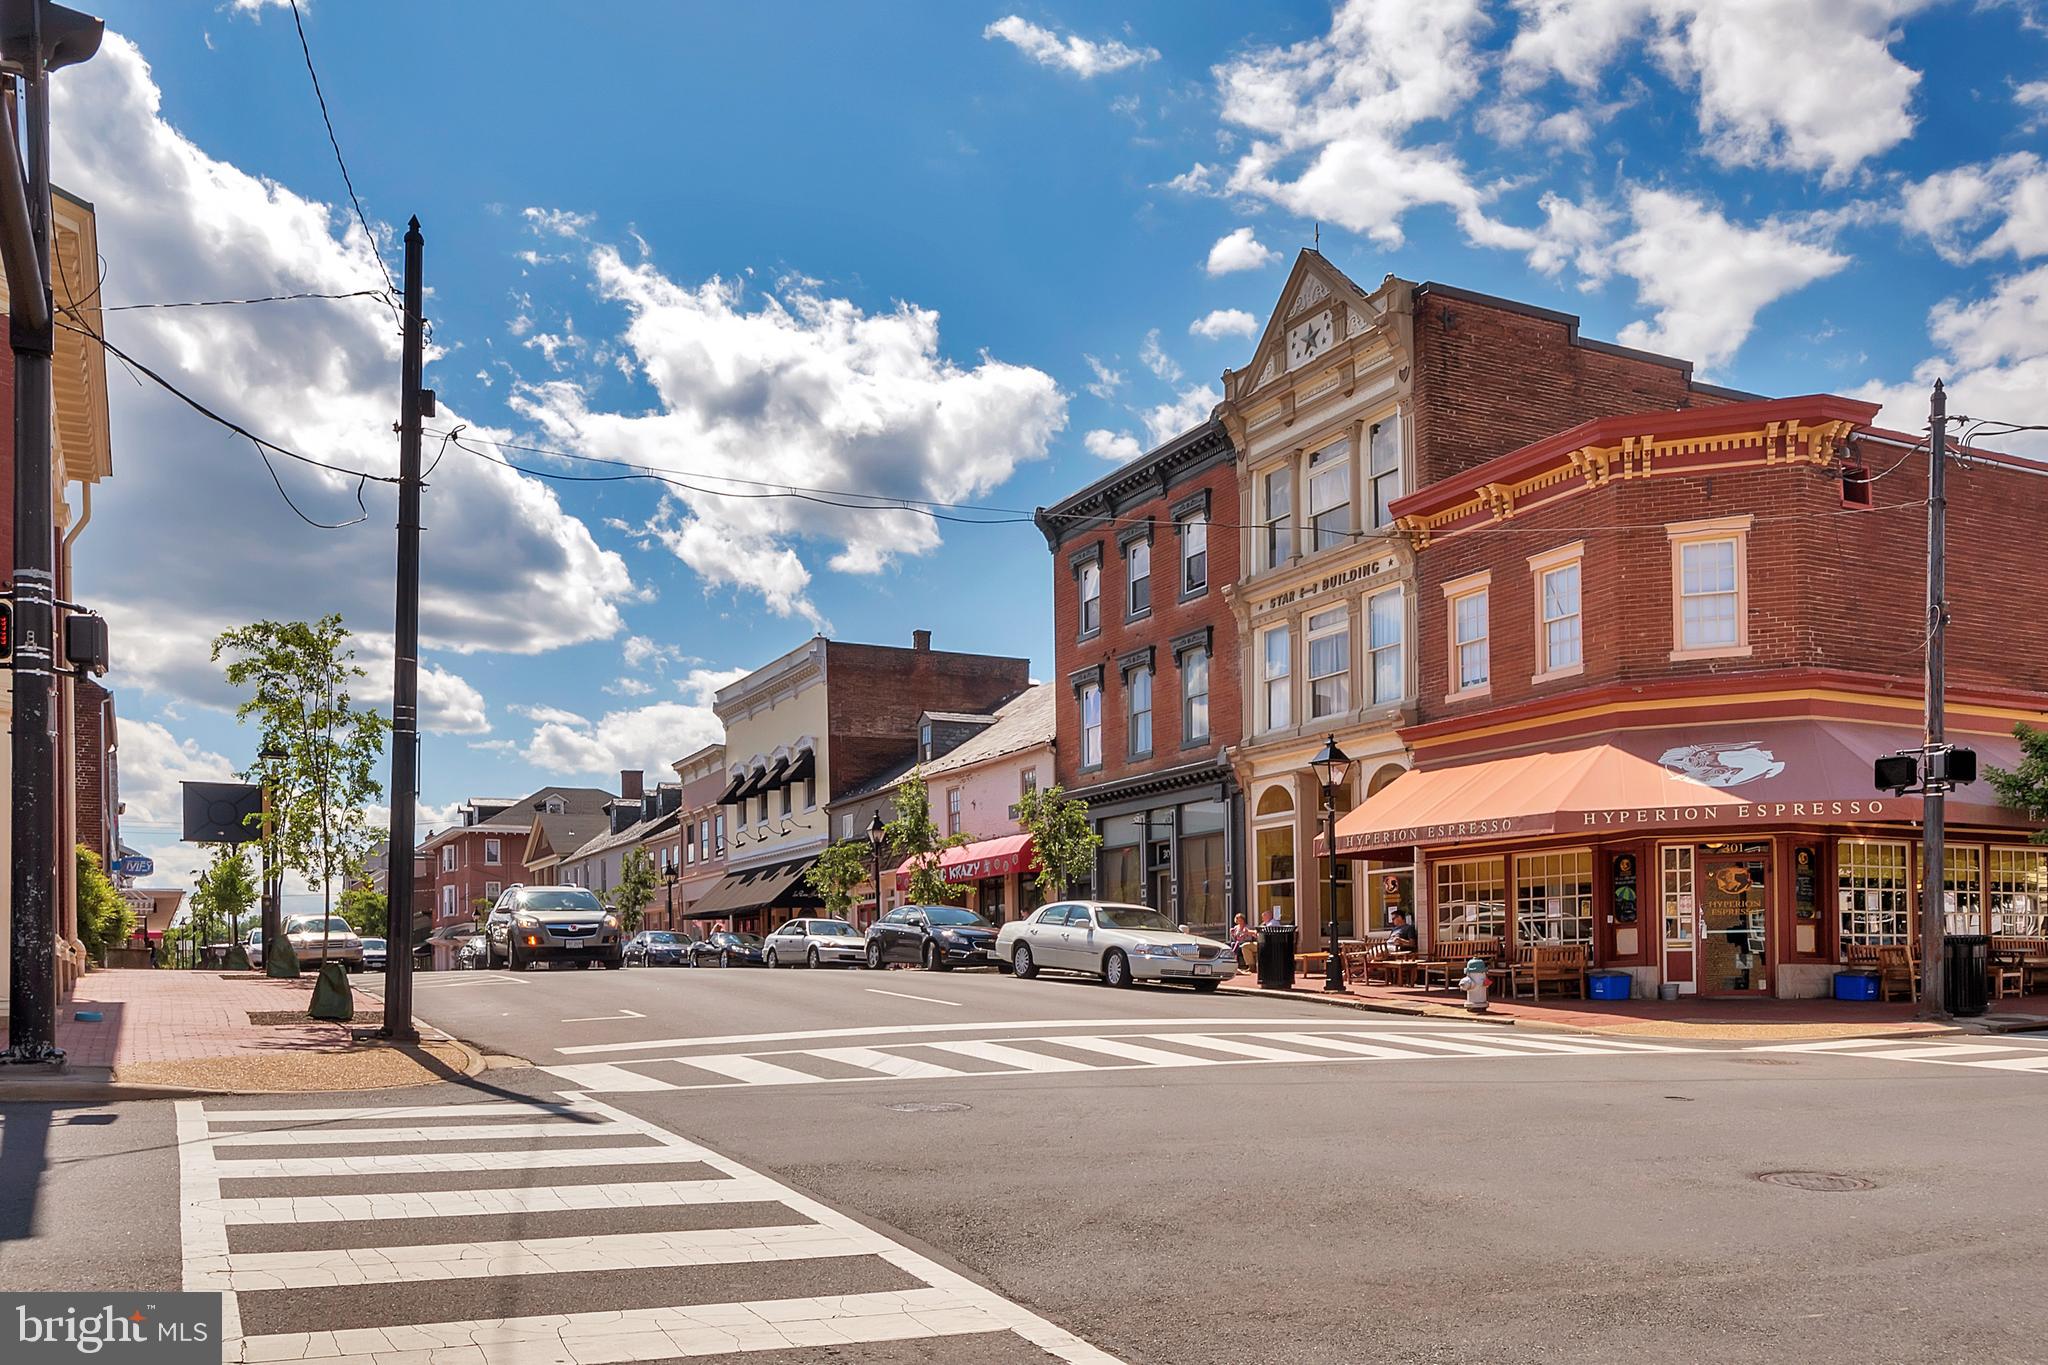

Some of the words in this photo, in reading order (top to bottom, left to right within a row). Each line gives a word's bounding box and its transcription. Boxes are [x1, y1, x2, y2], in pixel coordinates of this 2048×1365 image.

[1270, 590, 1295, 608] STAR
[1322, 562, 1380, 590] BUILDING
[1583, 806, 1718, 825] HYPERION
[1738, 801, 1884, 818] ESPRESSO
[1346, 827, 1418, 847] HYPERION
[1428, 818, 1513, 837] ESPRESSO
[1722, 842, 1743, 854] 301
[950, 862, 980, 880] KRAZY
[1708, 900, 1761, 909] HYPERION
